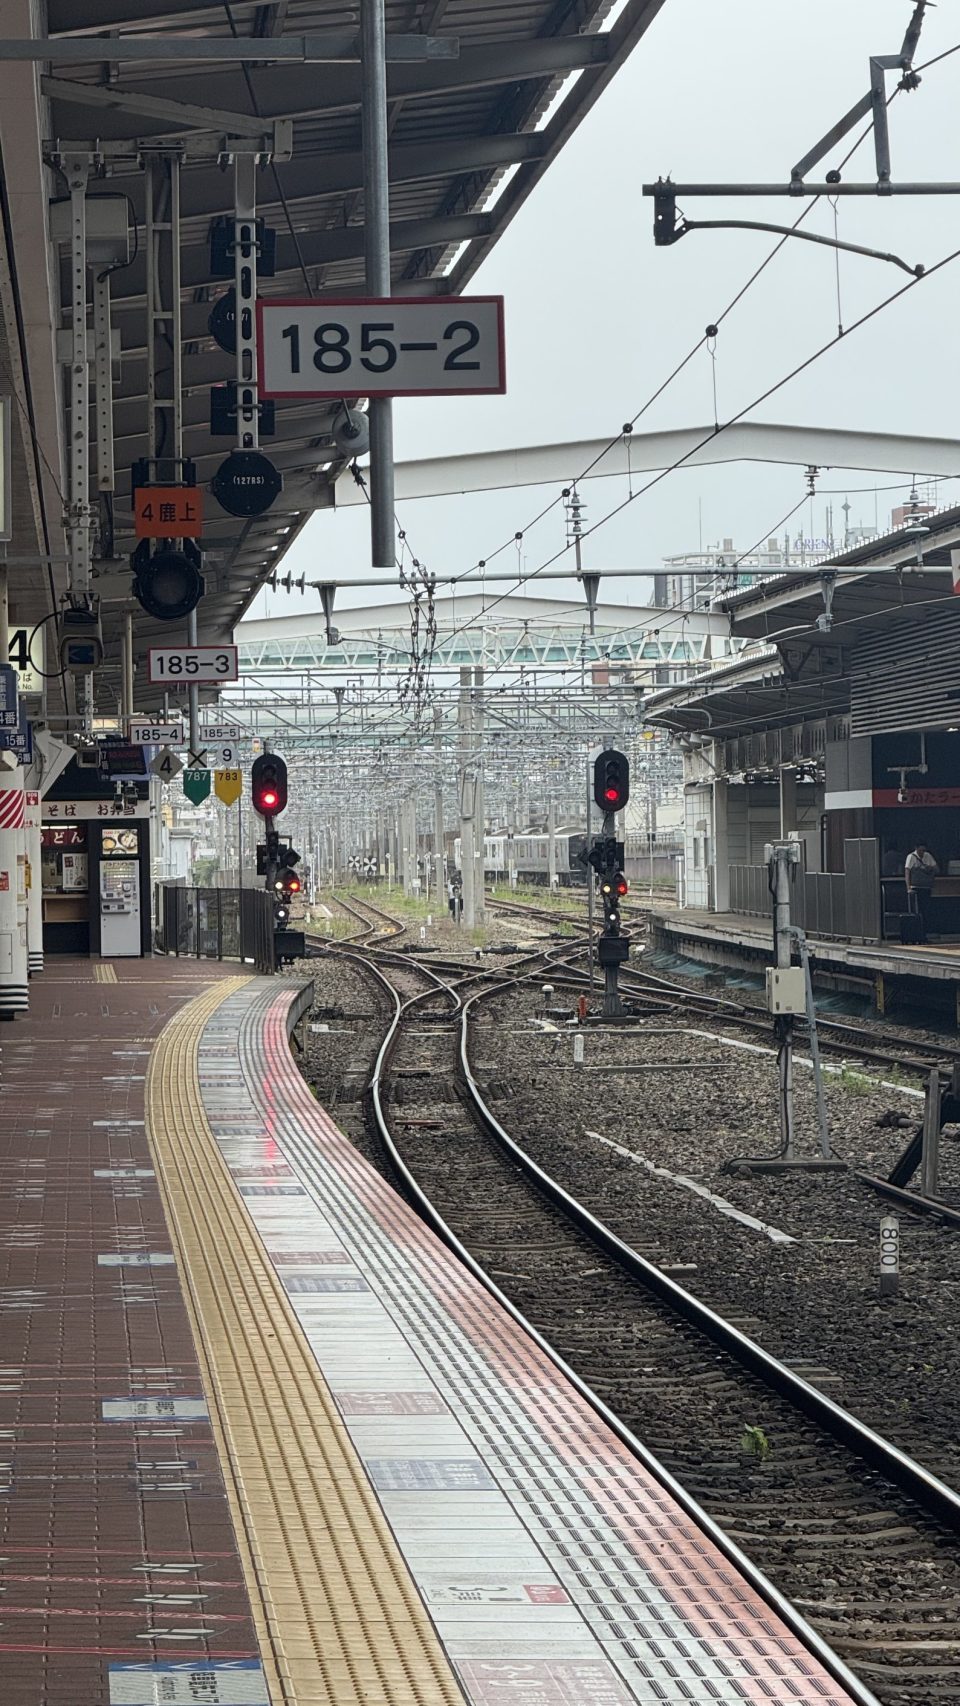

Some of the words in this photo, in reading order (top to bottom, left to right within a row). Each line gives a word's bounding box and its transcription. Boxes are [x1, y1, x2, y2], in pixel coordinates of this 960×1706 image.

[282, 320, 481, 374] 185-2
[157, 654, 230, 675] 185-3
[135, 729, 179, 741] 185-4
[204, 728, 236, 738] 185-5
[222, 748, 232, 762] 9
[160, 756, 173, 773] 4
[187, 771, 207, 781] 787
[218, 772, 238, 781] 783
[48, 804, 77, 817] そば
